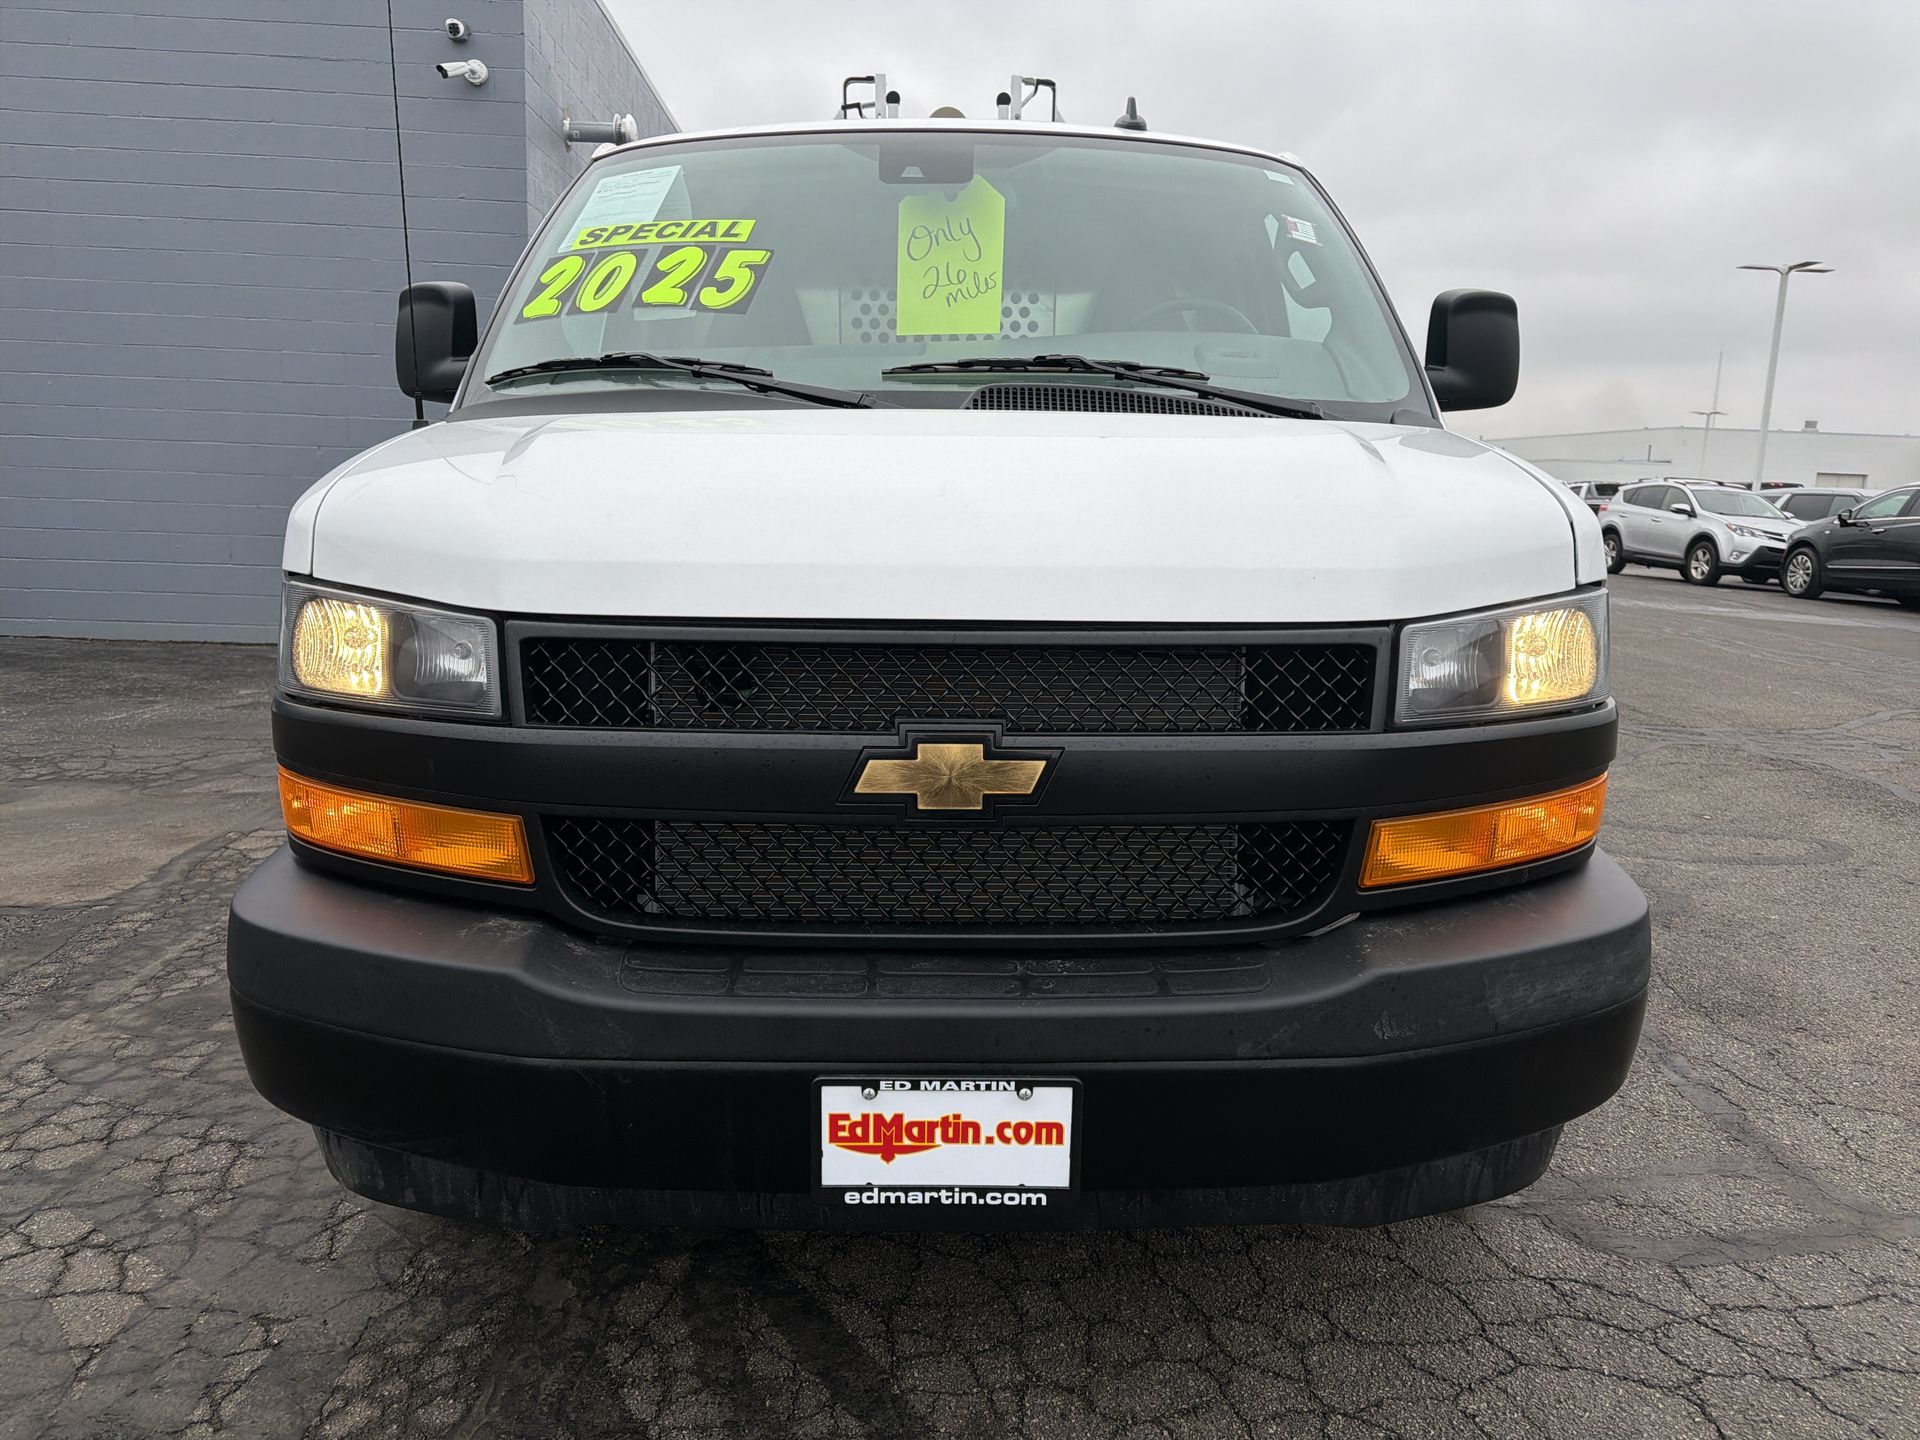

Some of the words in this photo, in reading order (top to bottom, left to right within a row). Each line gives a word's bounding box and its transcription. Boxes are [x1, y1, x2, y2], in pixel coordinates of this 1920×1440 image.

[579, 220, 743, 246] SPECIAL
[907, 215, 982, 262] Only
[522, 245, 772, 319] 2025
[922, 261, 967, 299] 26
[945, 271, 997, 308] miles
[879, 1080, 912, 1091] ED
[919, 1080, 1016, 1091] MARTIN
[828, 1112, 1065, 1164] EdMartin.com
[844, 1187, 1047, 1206] edmartin.com
